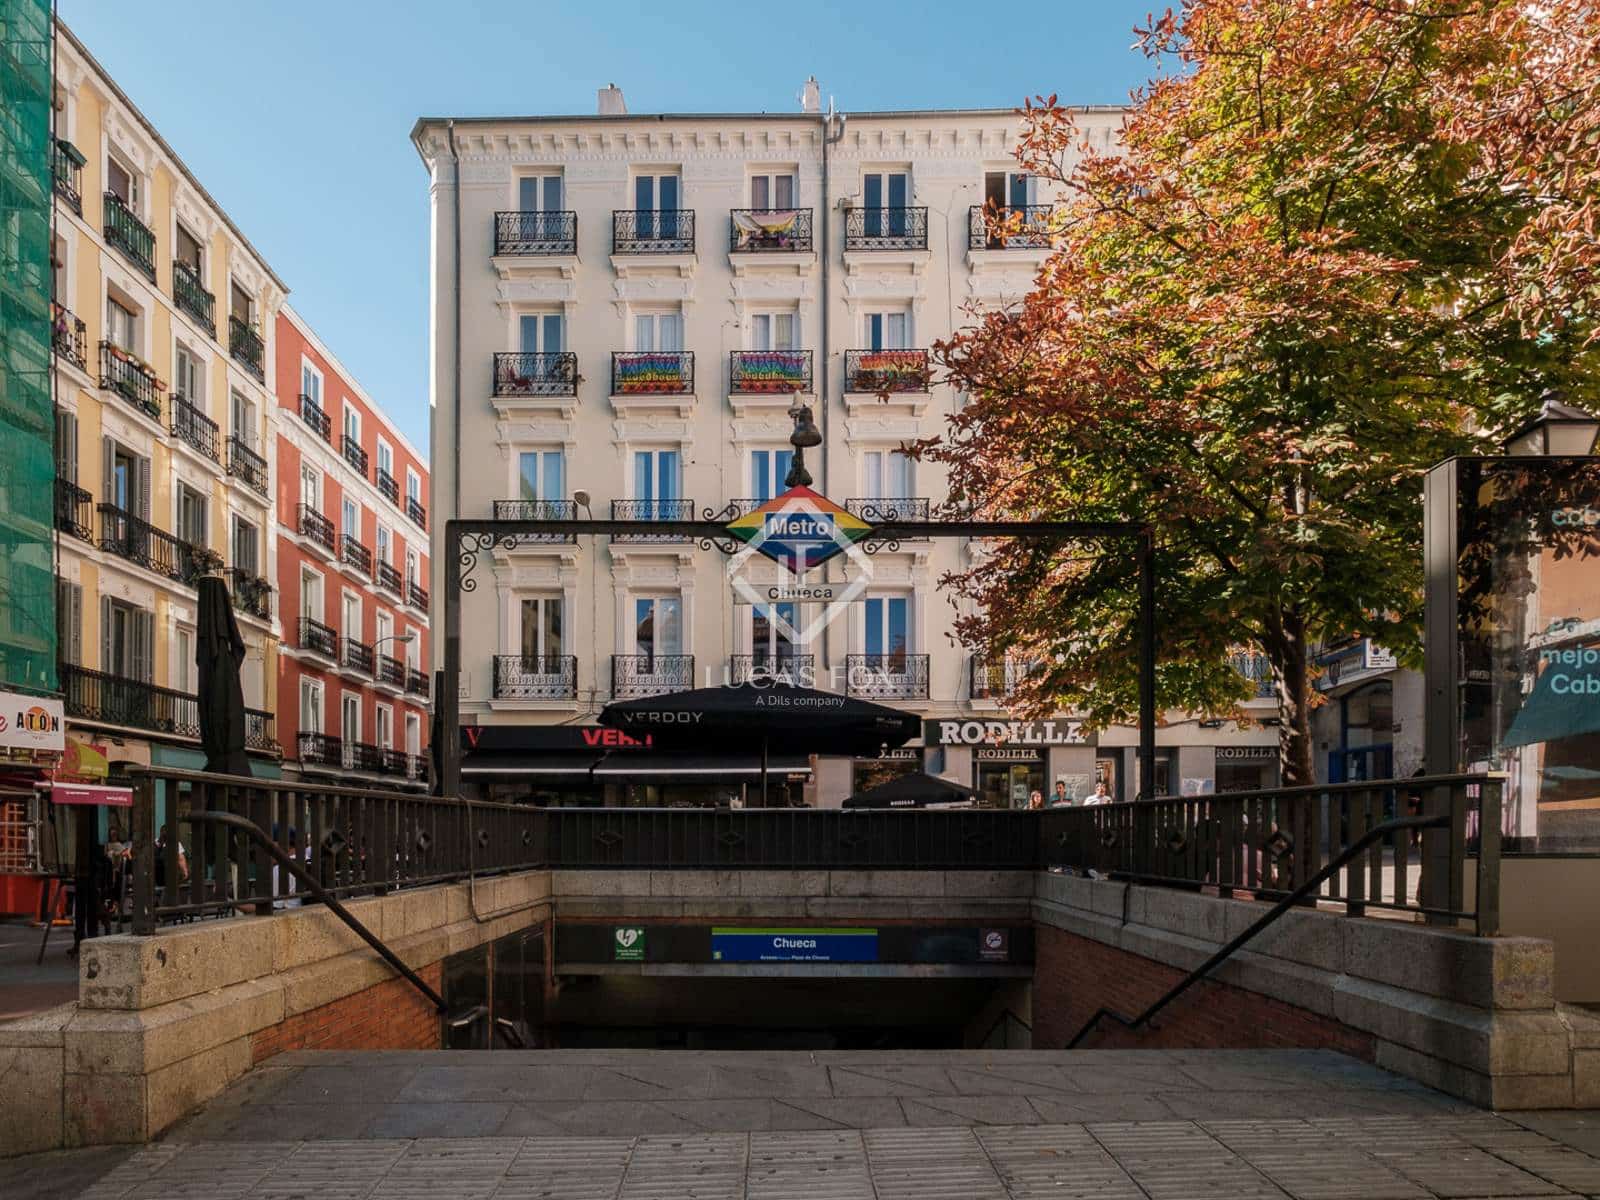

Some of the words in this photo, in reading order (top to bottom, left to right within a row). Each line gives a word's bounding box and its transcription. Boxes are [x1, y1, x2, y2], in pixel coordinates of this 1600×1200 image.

[770, 518, 830, 535] Metro
[767, 587, 833, 600] Chueca
[1540, 643, 1600, 669] mejo
[1551, 673, 1600, 694] Cab
[623, 711, 704, 723] VERDOY
[465, 727, 484, 748] V
[939, 721, 1086, 744] RODILLA
[978, 749, 1039, 759] RODILLA
[1216, 747, 1277, 759] RODILLA
[773, 937, 817, 948] Chueca
